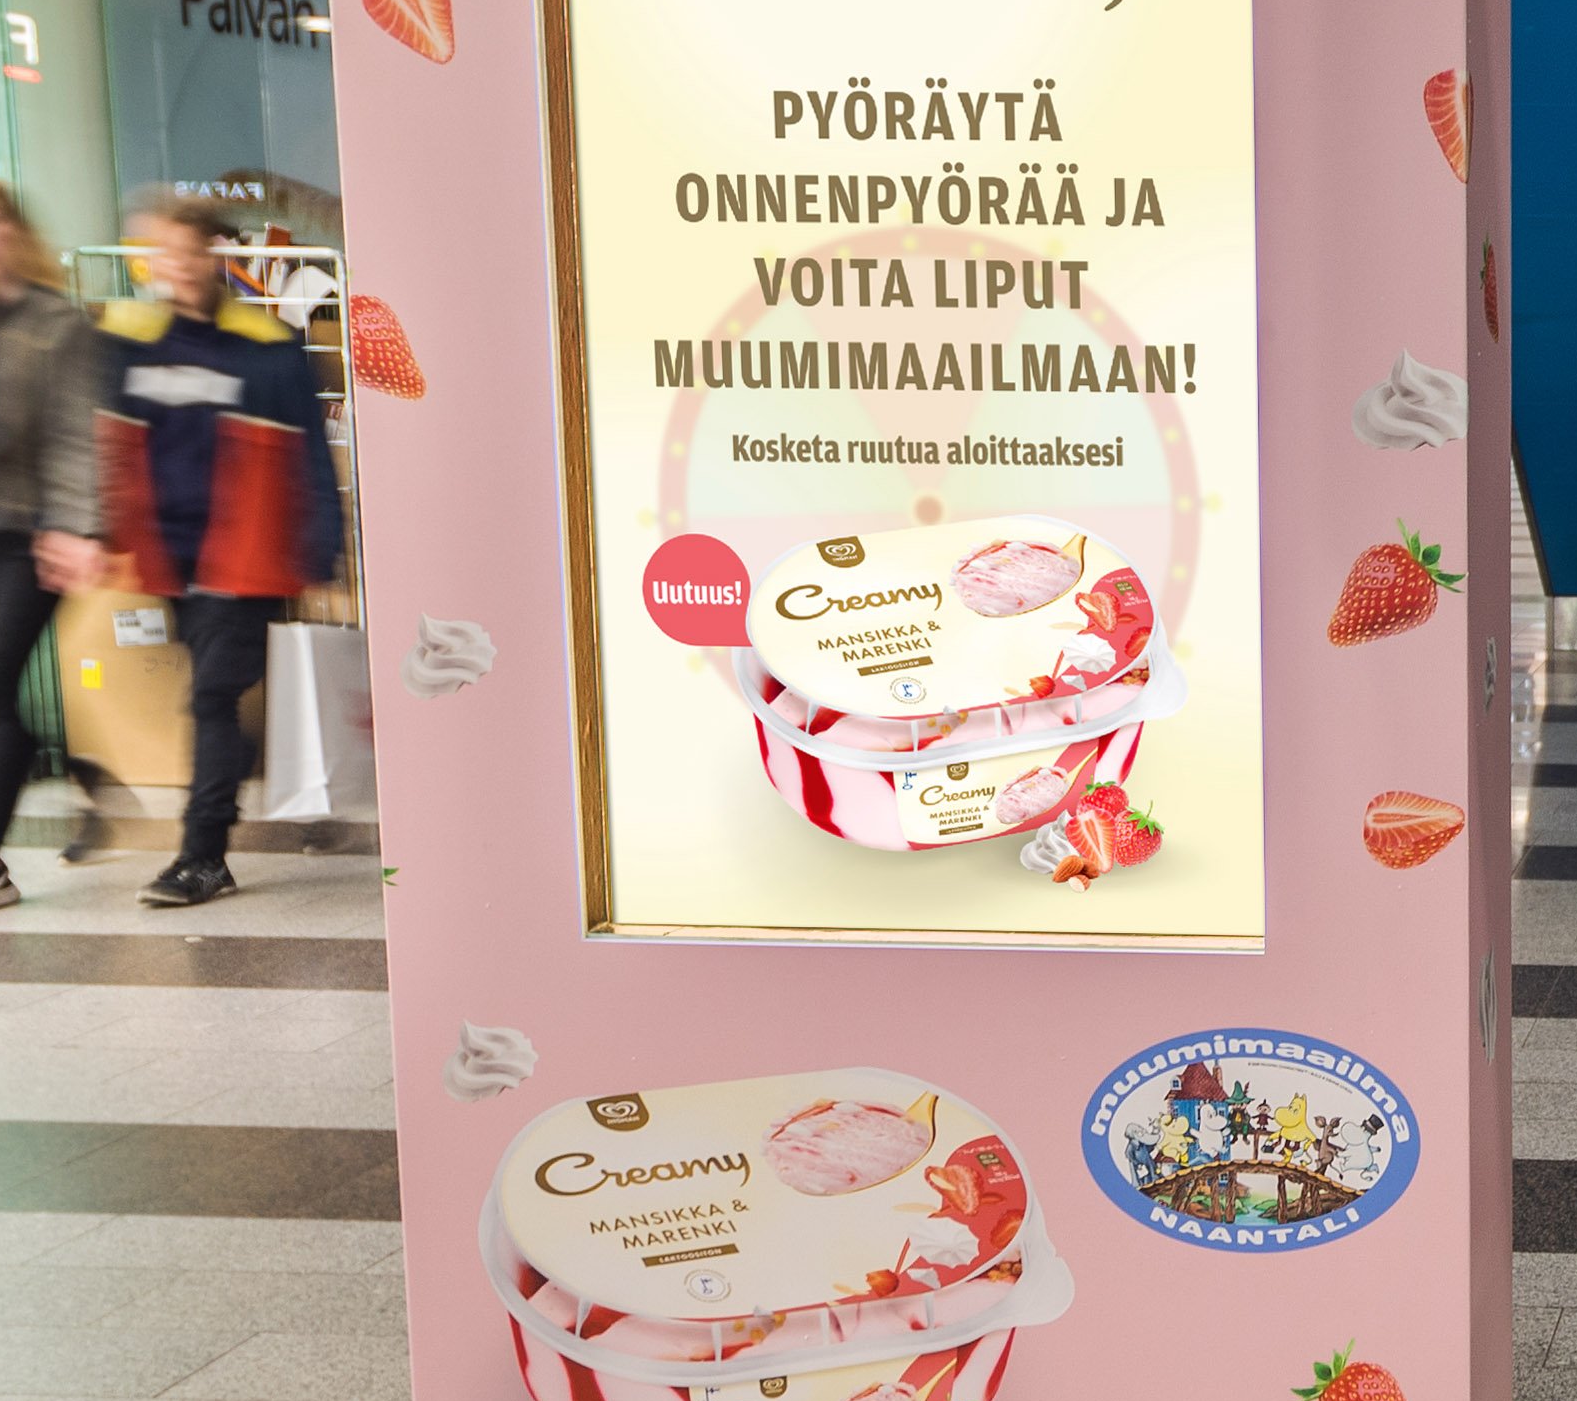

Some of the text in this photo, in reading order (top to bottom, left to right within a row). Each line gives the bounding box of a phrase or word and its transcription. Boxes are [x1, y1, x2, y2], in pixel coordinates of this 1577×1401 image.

[772, 77, 1063, 142] PYÖRÄYTÄ
[675, 163, 1165, 227] ONNENPYÖRÄÄ JA
[753, 257, 1089, 310] VOITA LIPUT
[653, 339, 1198, 395] MUUMIMAAILMAAN!
[732, 434, 1124, 468] Kosketa ruutua aloittaaksesi
[652, 579, 743, 606] Uutuus!
[775, 583, 942, 621] Creamy
[817, 620, 941, 650] MANSIKKA &
[842, 637, 932, 663] MARENKI
[919, 785, 996, 806] Creamy
[1090, 1034, 1411, 1145] muumimaailma
[534, 1152, 752, 1197] Creamy
[589, 1198, 750, 1235] MANSIKKA &
[622, 1220, 738, 1250] MARENKI
[1149, 1206, 1361, 1246] NAANTALI
